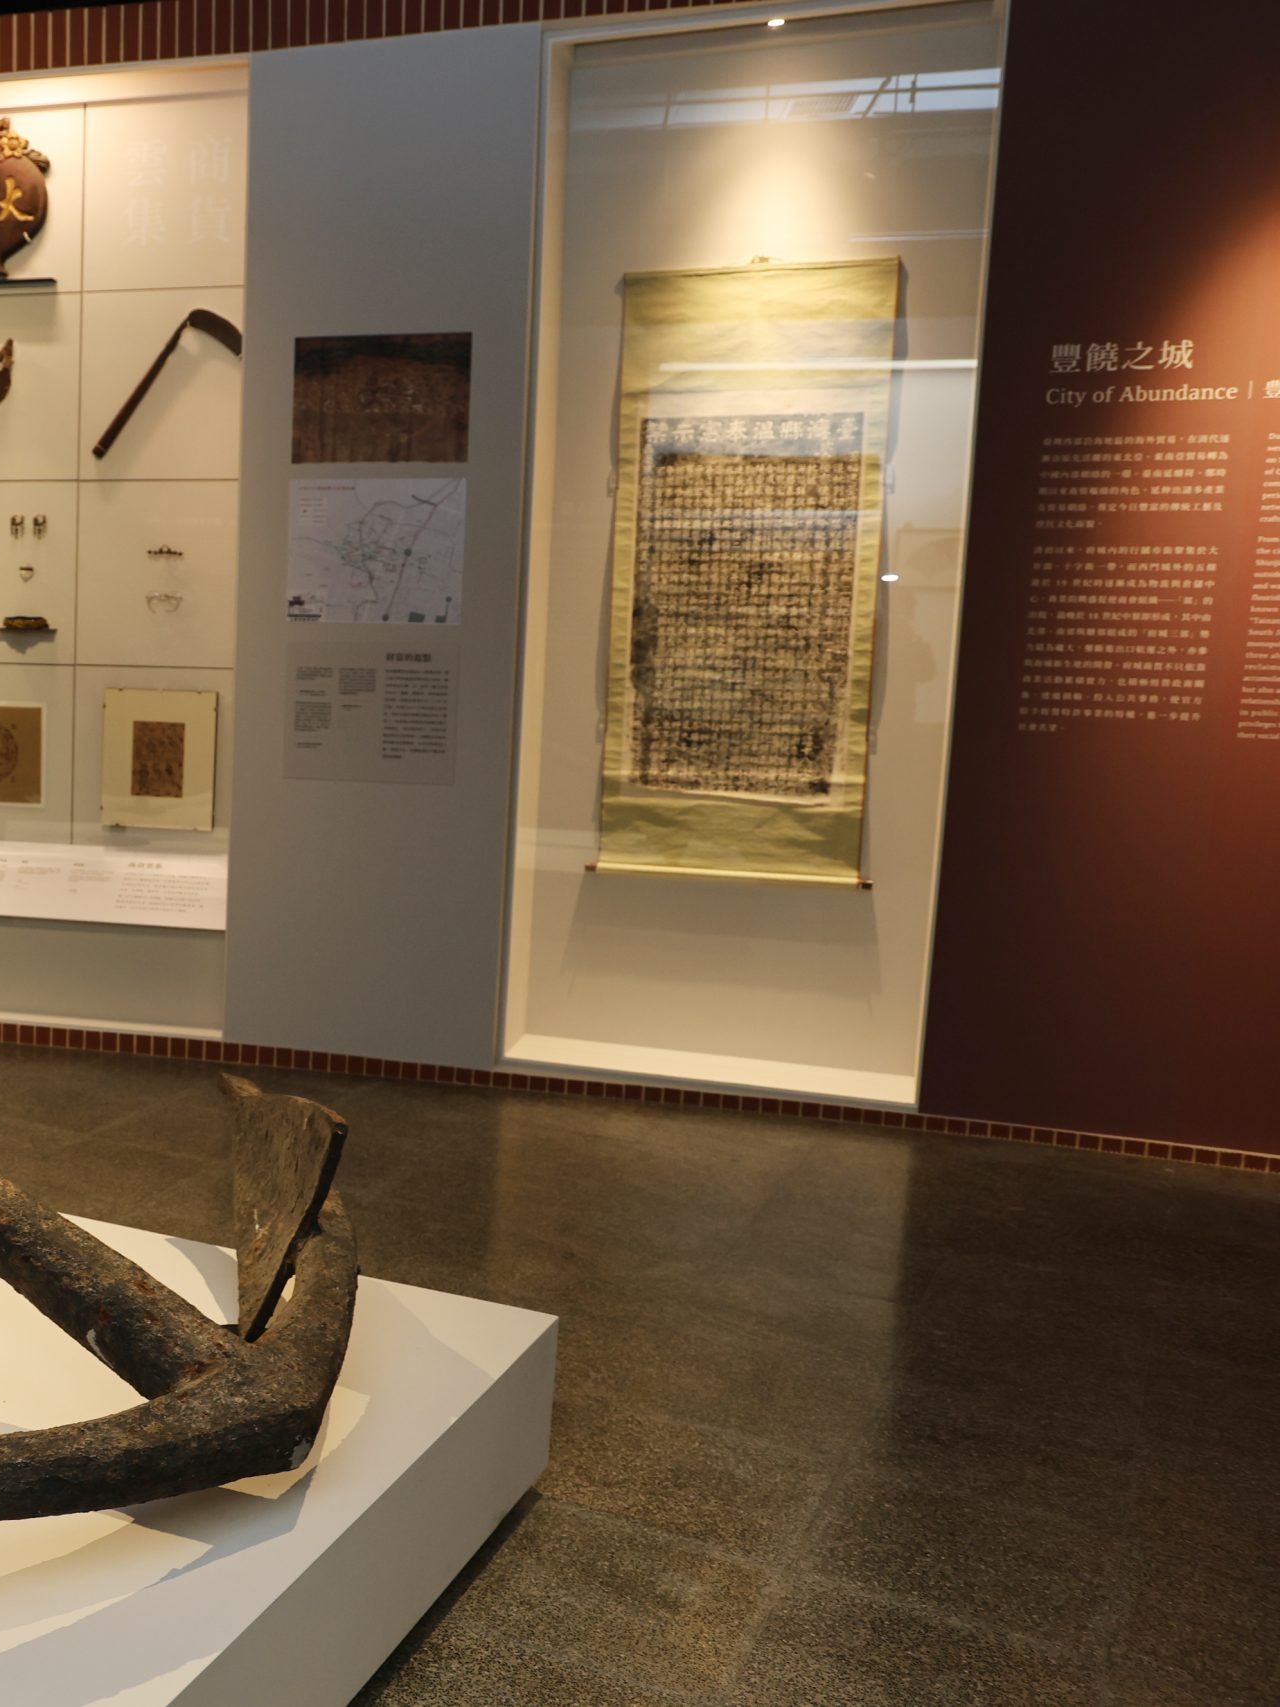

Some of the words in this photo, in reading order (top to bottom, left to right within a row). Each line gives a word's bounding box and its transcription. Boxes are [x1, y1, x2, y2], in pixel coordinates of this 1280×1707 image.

[1048, 339, 1195, 374] 豐饒之城
[1045, 387, 1087, 408] City
[1092, 386, 1116, 404] of
[1118, 383, 1240, 403] Abundance
